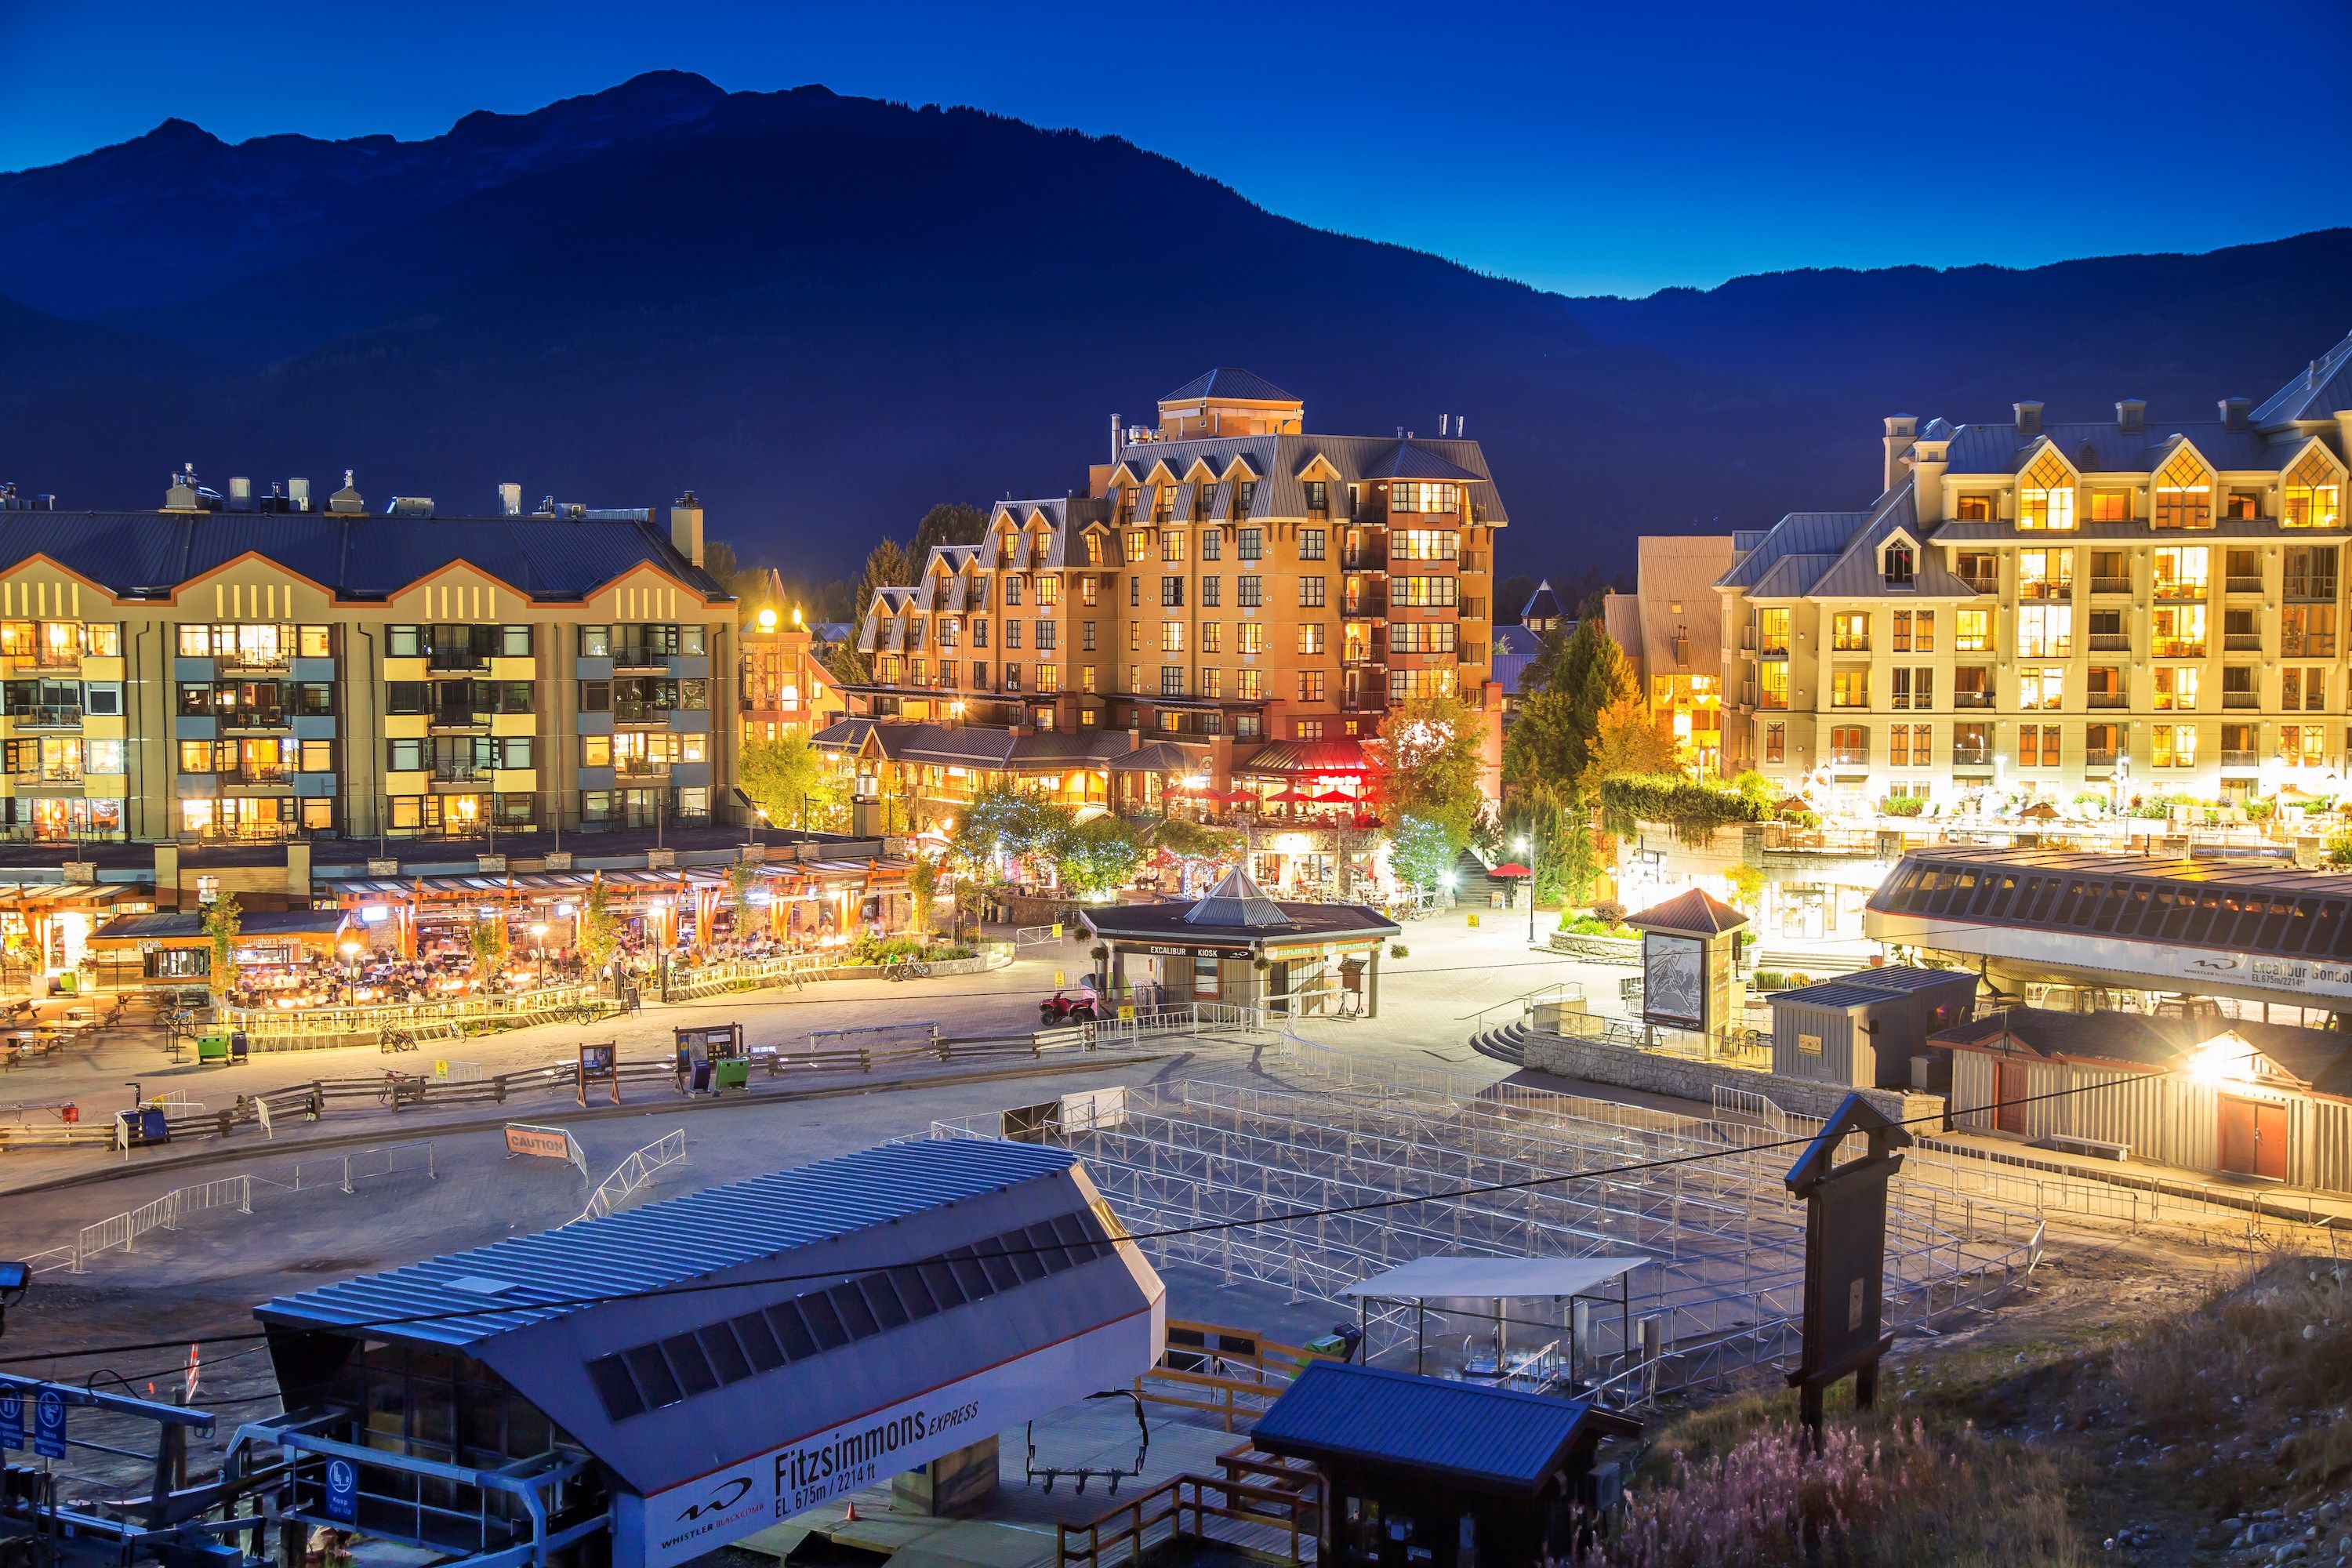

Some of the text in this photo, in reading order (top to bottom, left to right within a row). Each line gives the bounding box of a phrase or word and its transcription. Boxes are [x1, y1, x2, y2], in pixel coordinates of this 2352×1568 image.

[278, 935, 301, 944] Saloon
[1150, 946, 1218, 957] EXCALIBUR KIOSK
[2252, 959, 2307, 979] Excalibur
[511, 1135, 563, 1152] CAUTION
[775, 1400, 980, 1497] Fitzsimmons EXPRESS
[775, 1497, 792, 1519] EL.
[795, 1483, 826, 1510] 675m
[837, 1468, 863, 1494] 2214
[867, 1462, 876, 1481] ft
[330, 1504, 341, 1513] Tips
[332, 1496, 347, 1505] Keep
[661, 1503, 764, 1550] WHISTLER BLACKCOMB
